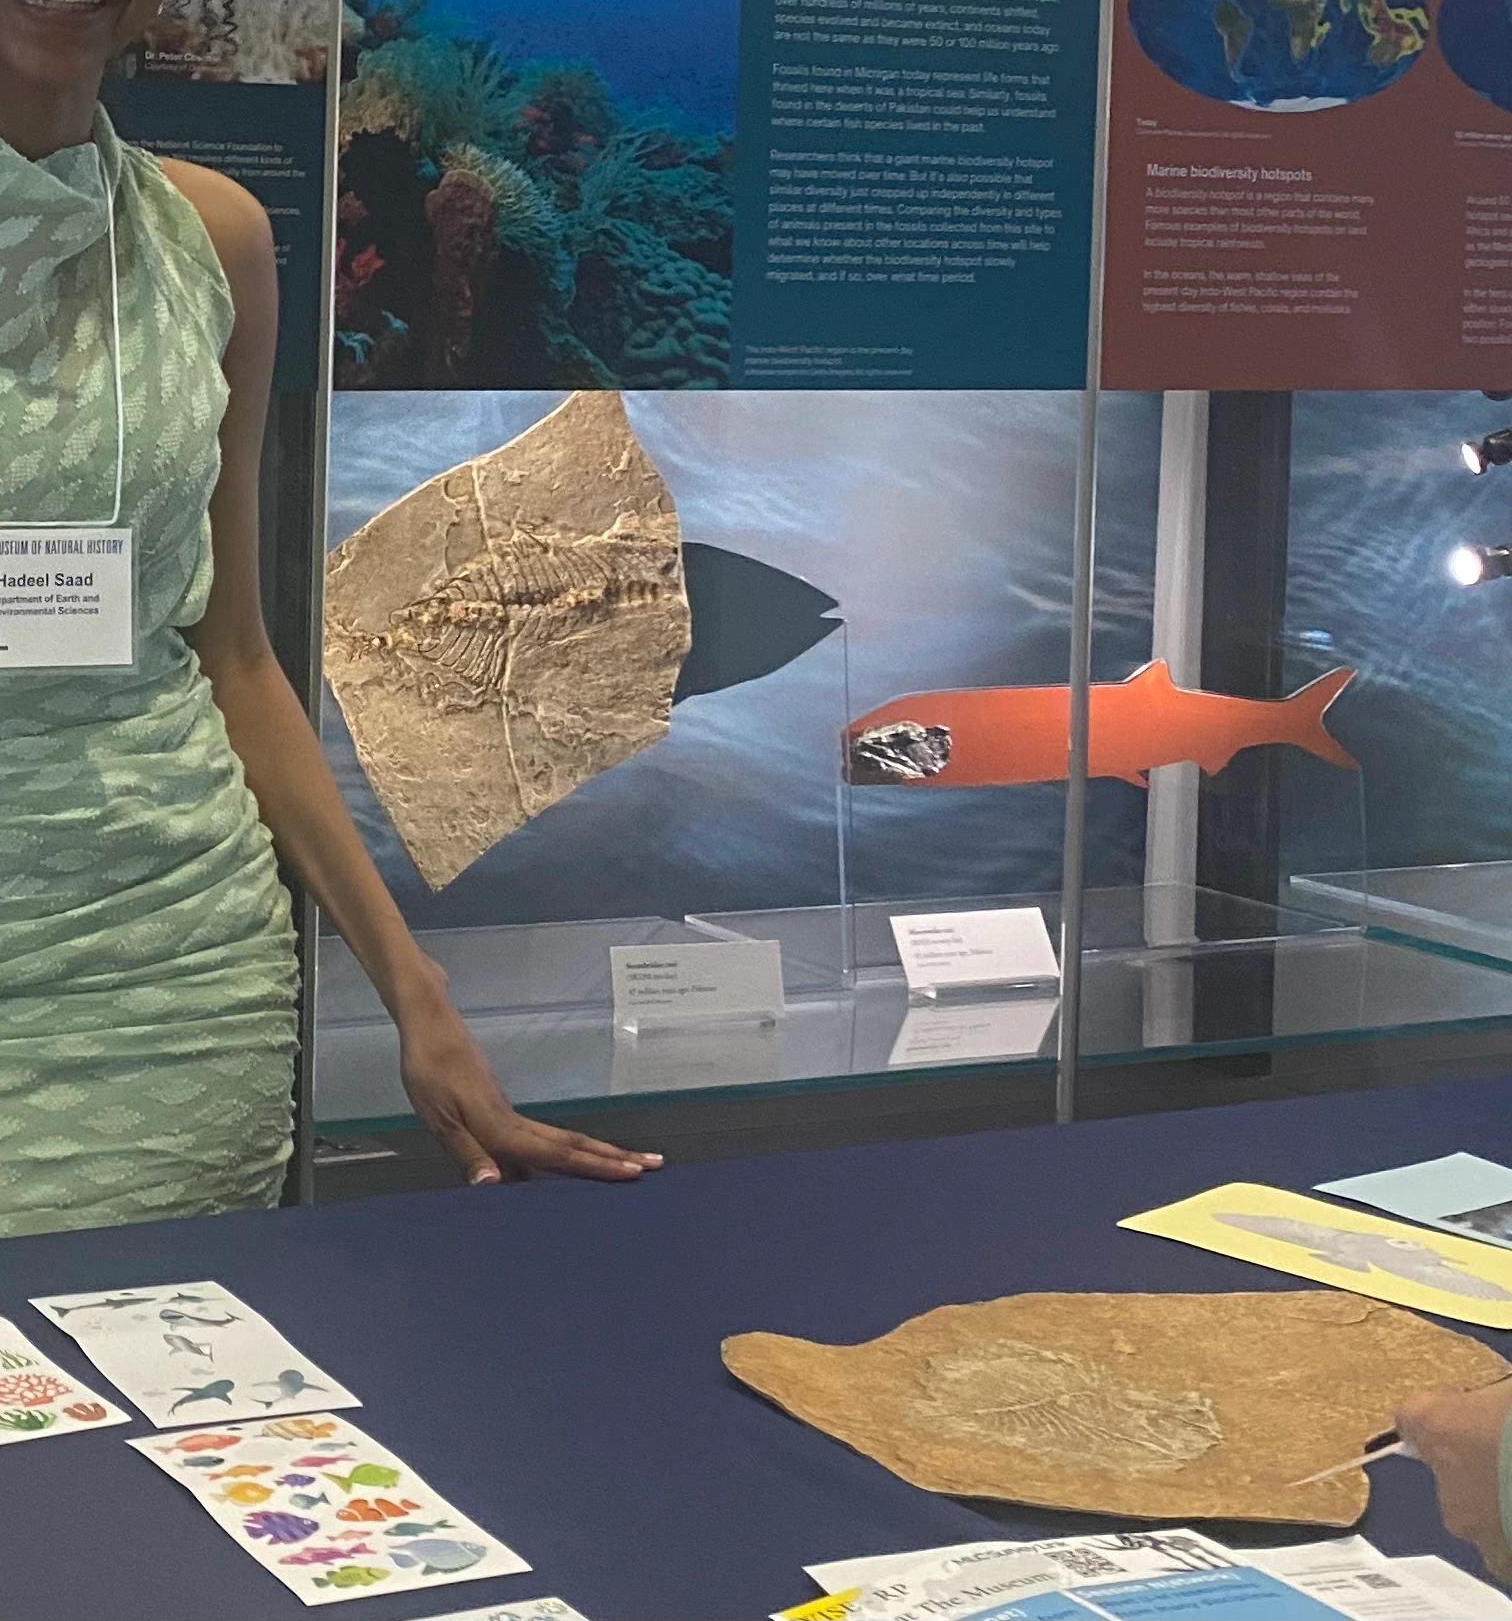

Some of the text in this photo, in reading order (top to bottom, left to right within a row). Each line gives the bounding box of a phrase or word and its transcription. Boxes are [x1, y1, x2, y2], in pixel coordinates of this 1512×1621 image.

[1147, 163, 1312, 183] Marine biodiversity hotspots
[32, 540, 41, 555] OF
[45, 540, 83, 555] NATURAL
[87, 539, 124, 555] HISTORY
[55, 573, 93, 587] Saad
[45, 595, 53, 603] of
[56, 594, 80, 603] Earth
[83, 595, 100, 603] and
[58, 606, 99, 615] Sciences
[913, 1596, 964, 1614] The
[961, 1572, 1056, 1600] Museum
